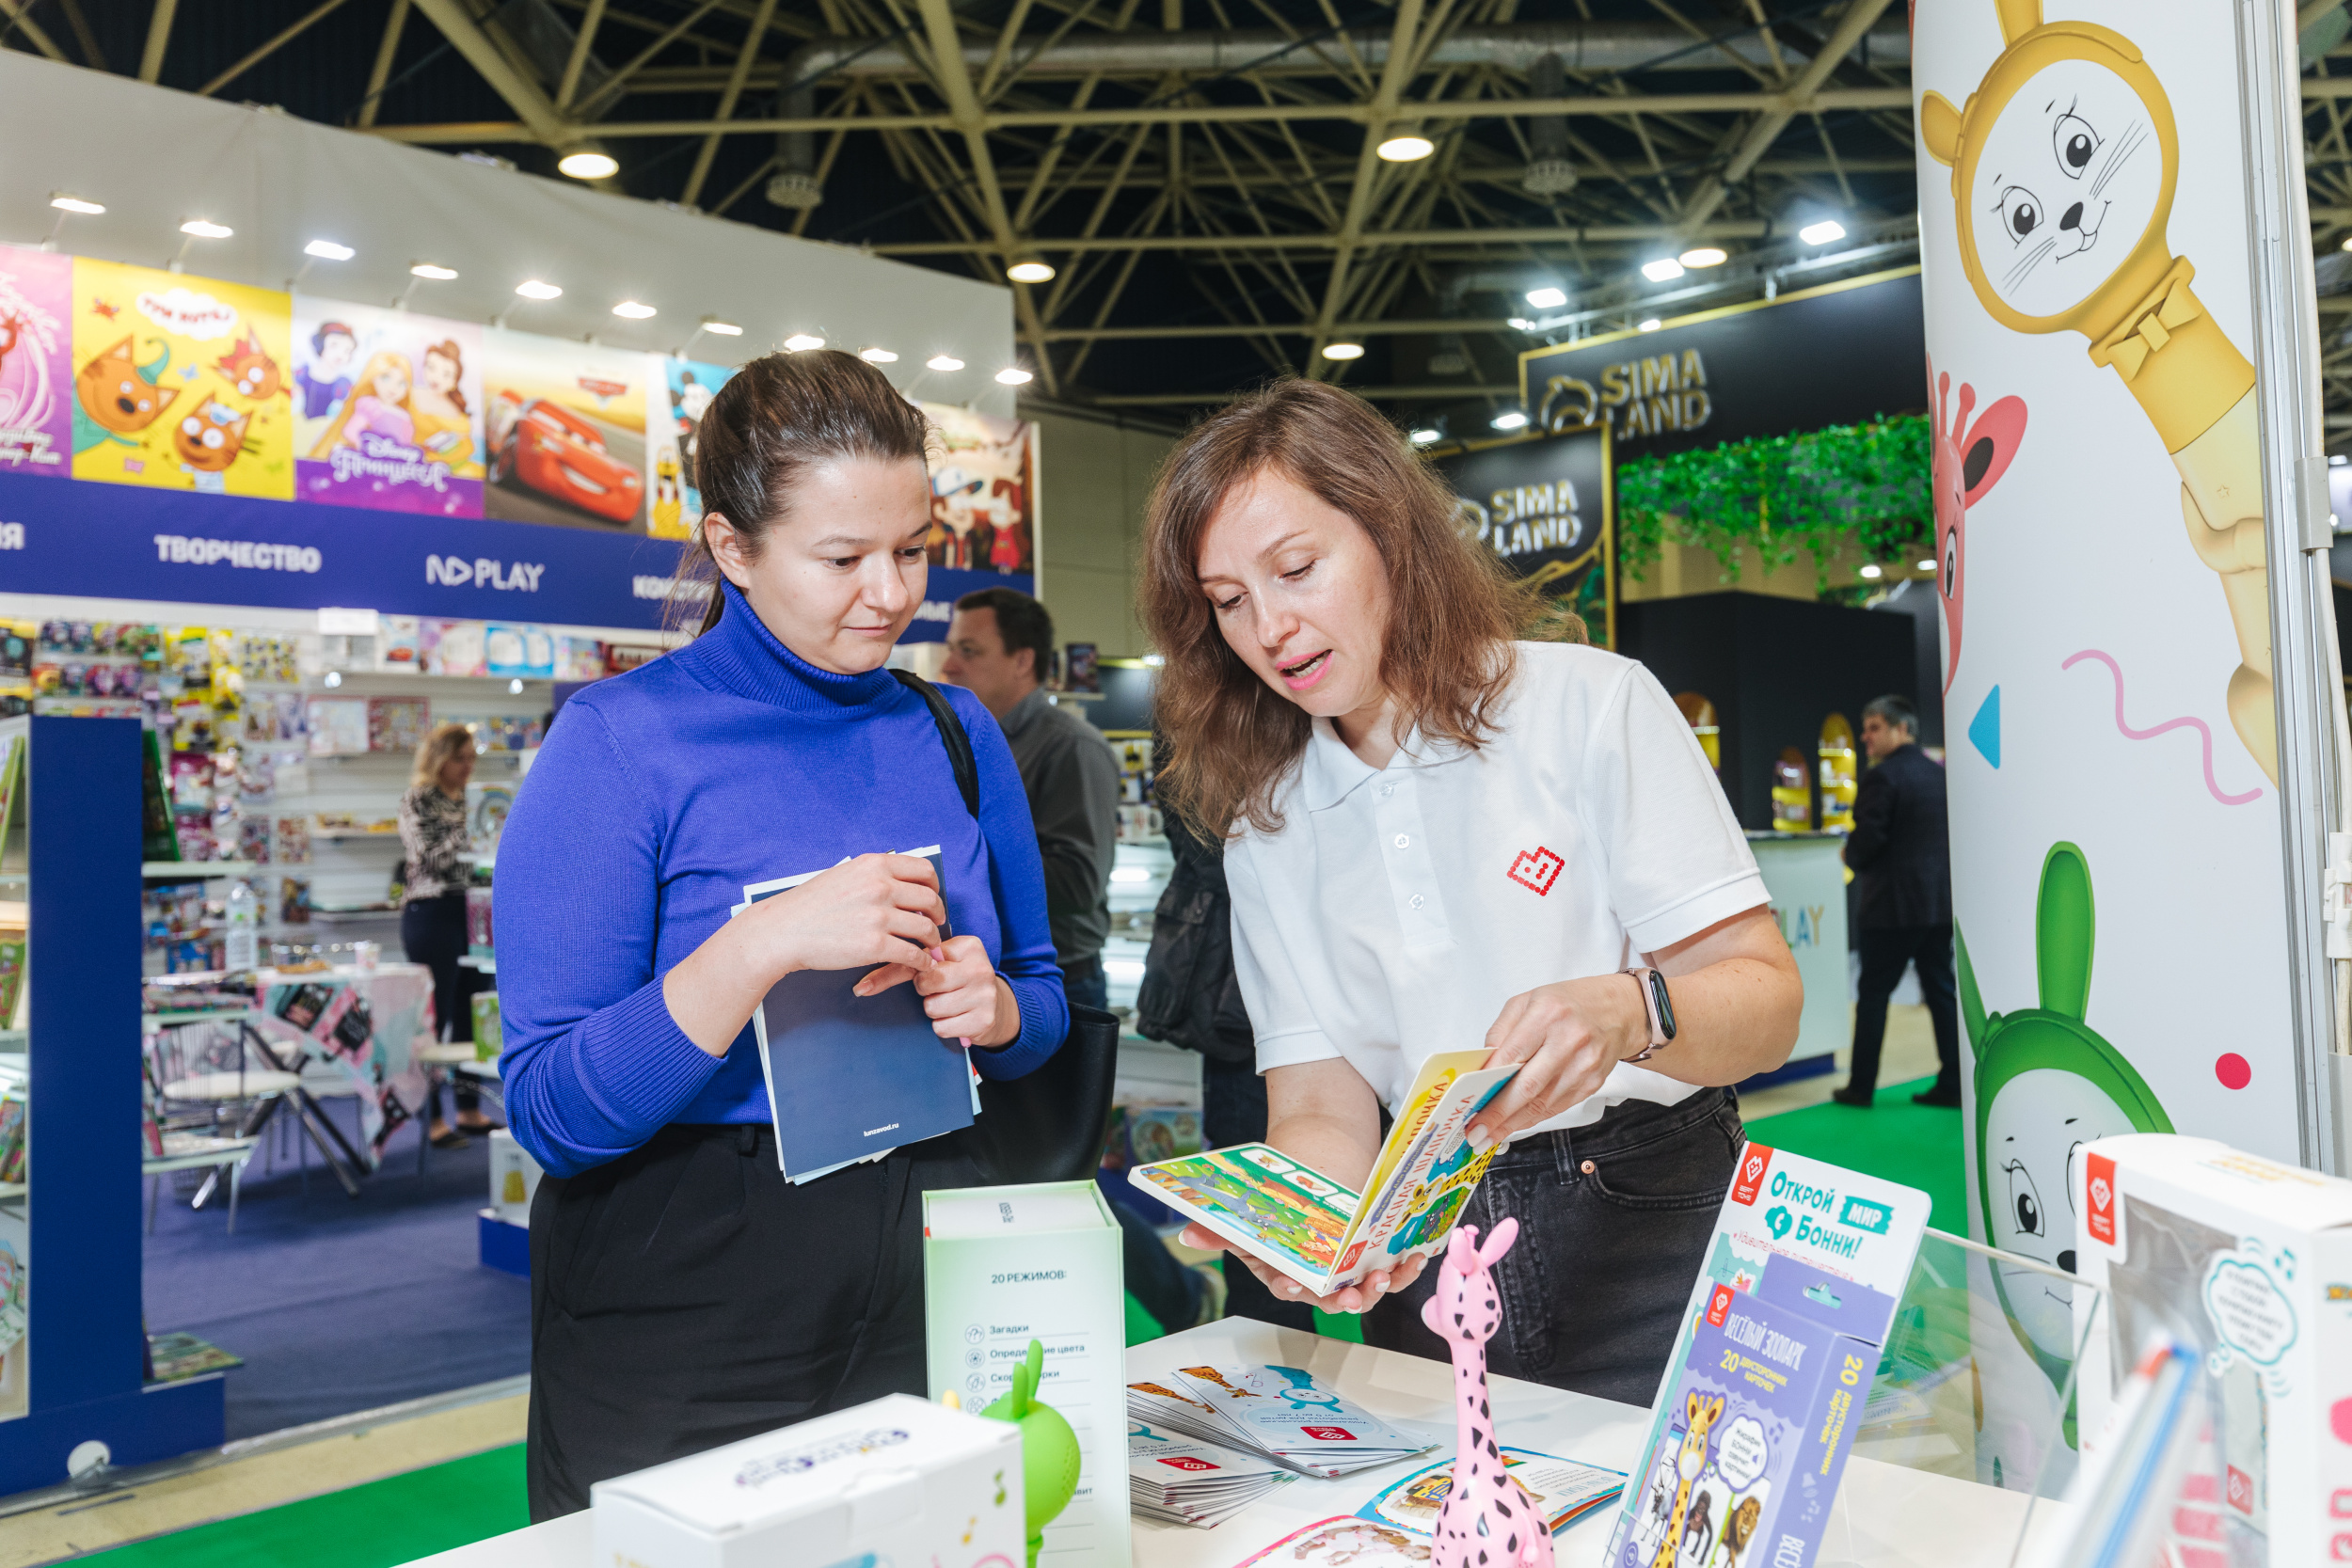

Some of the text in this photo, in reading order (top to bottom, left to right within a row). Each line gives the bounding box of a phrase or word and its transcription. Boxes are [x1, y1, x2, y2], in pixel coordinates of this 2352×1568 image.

[1601, 349, 1707, 406] SIMA
[1602, 389, 1712, 440] LAND
[1490, 480, 1580, 522] SIMA
[153, 533, 323, 574] ТВОРЧЕСТВО
[1494, 514, 1582, 557] LAND
[1368, 1179, 1419, 1251] КРАСНАЯ
[1414, 1094, 1475, 1174] ШАПОЧКА
[991, 1270, 1067, 1284] 20 РЕЖИМОВ:
[990, 1324, 1029, 1336] Загадки
[1761, 1329, 1807, 1371] ЗООПАРК
[990, 1344, 1085, 1360] Опредеие цвета
[1720, 1349, 1740, 1373] 20
[1840, 1354, 1864, 1386] 20
